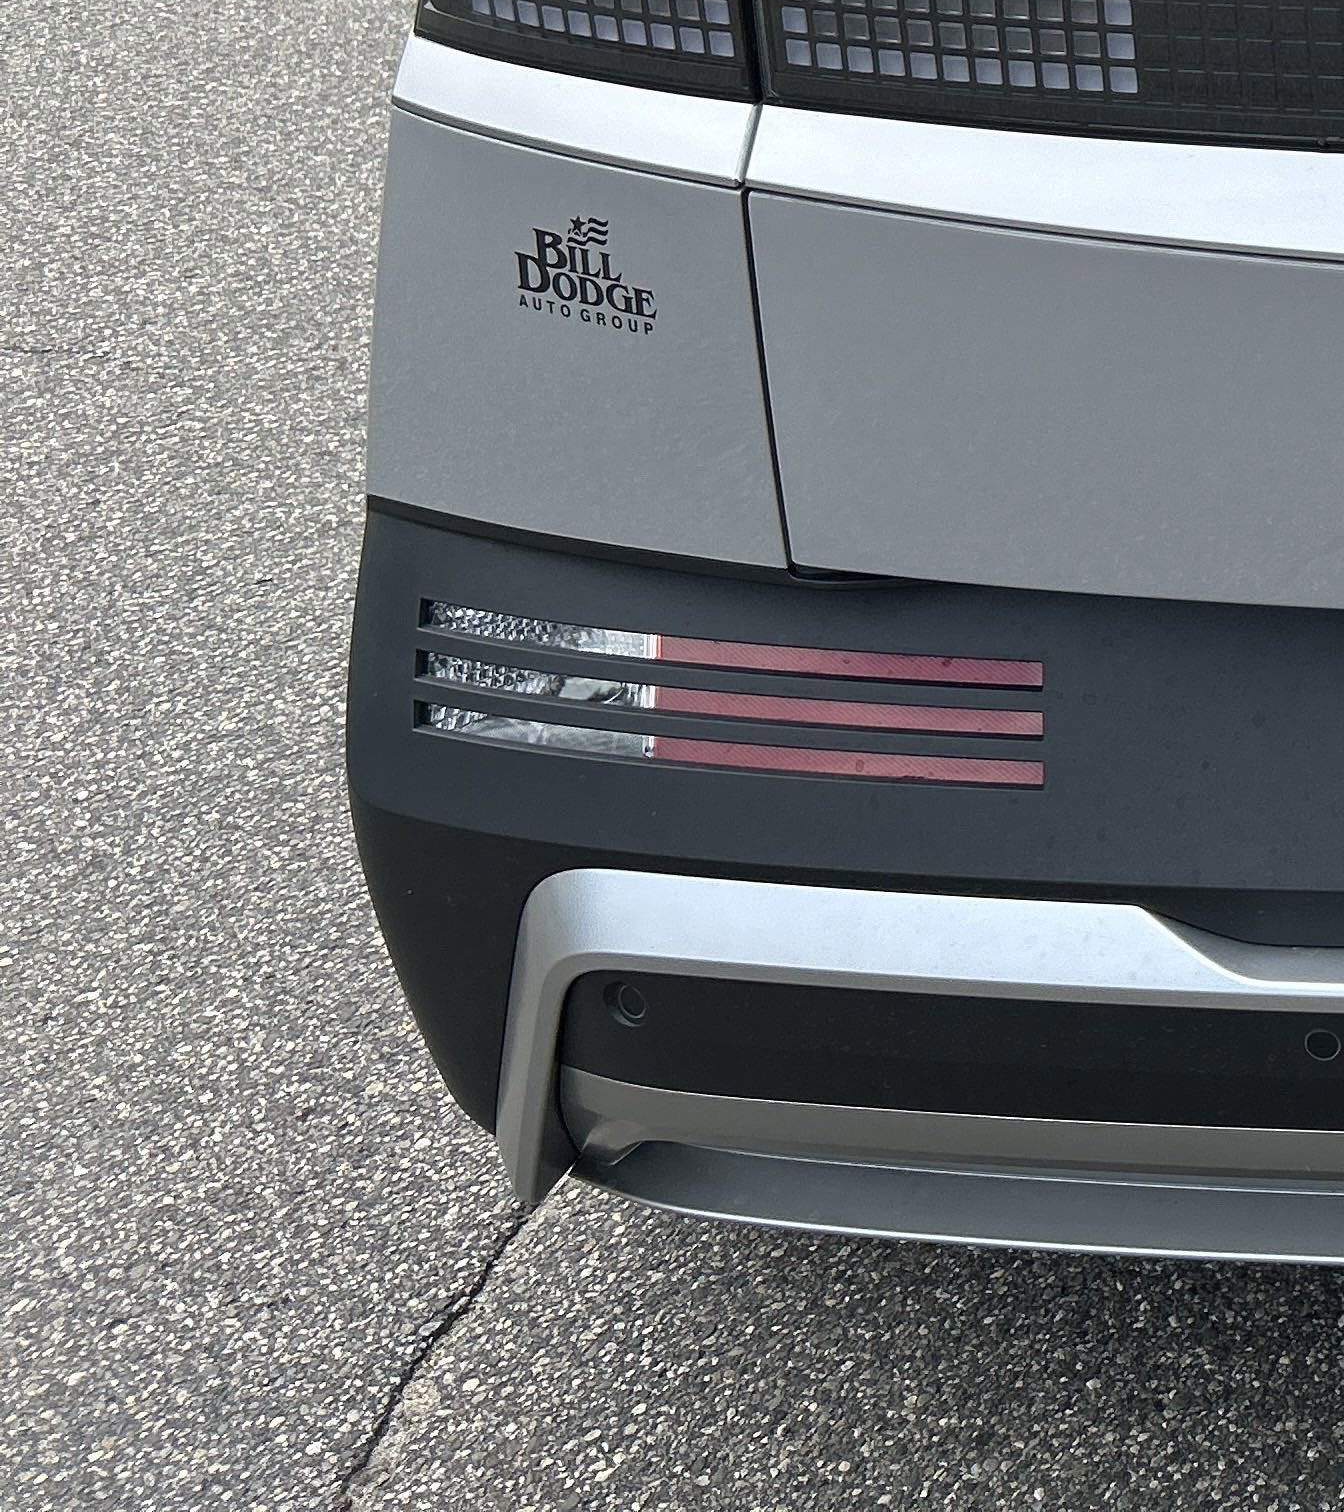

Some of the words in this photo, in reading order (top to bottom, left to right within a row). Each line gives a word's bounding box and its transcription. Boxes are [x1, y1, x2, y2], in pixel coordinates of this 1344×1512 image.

[532, 227, 623, 283] BILL
[514, 251, 658, 320] DODGE
[519, 293, 571, 318] AUTO
[580, 308, 655, 336] GROUP
